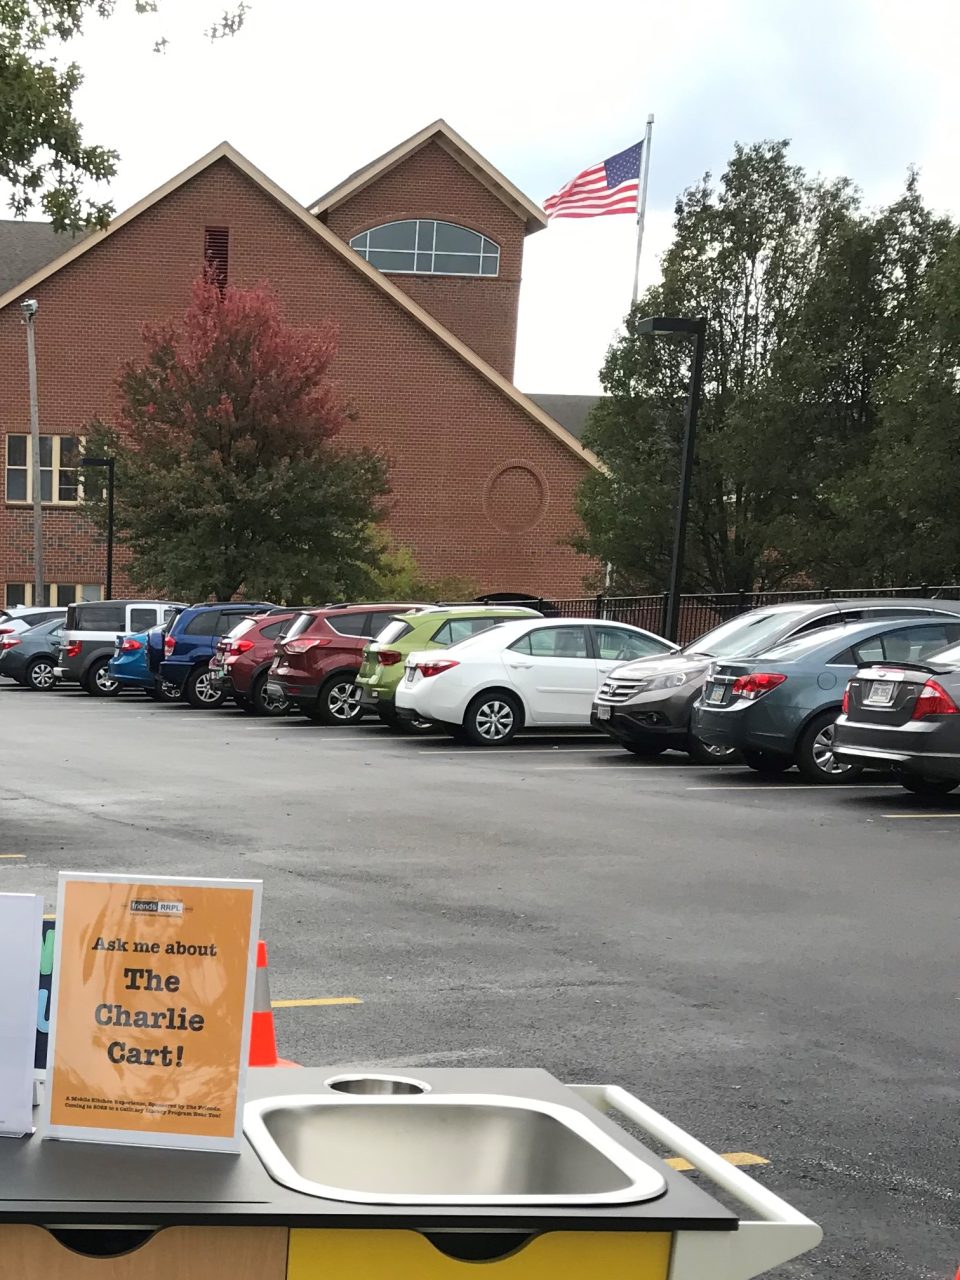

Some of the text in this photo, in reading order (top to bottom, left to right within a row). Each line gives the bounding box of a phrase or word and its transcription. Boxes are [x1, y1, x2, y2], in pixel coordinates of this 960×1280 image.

[131, 901, 181, 911] friends RRPL
[92, 937, 217, 957] Ask me about
[123, 968, 180, 992] The
[95, 1003, 205, 1031] Charlie
[107, 1041, 184, 1067] Cart!
